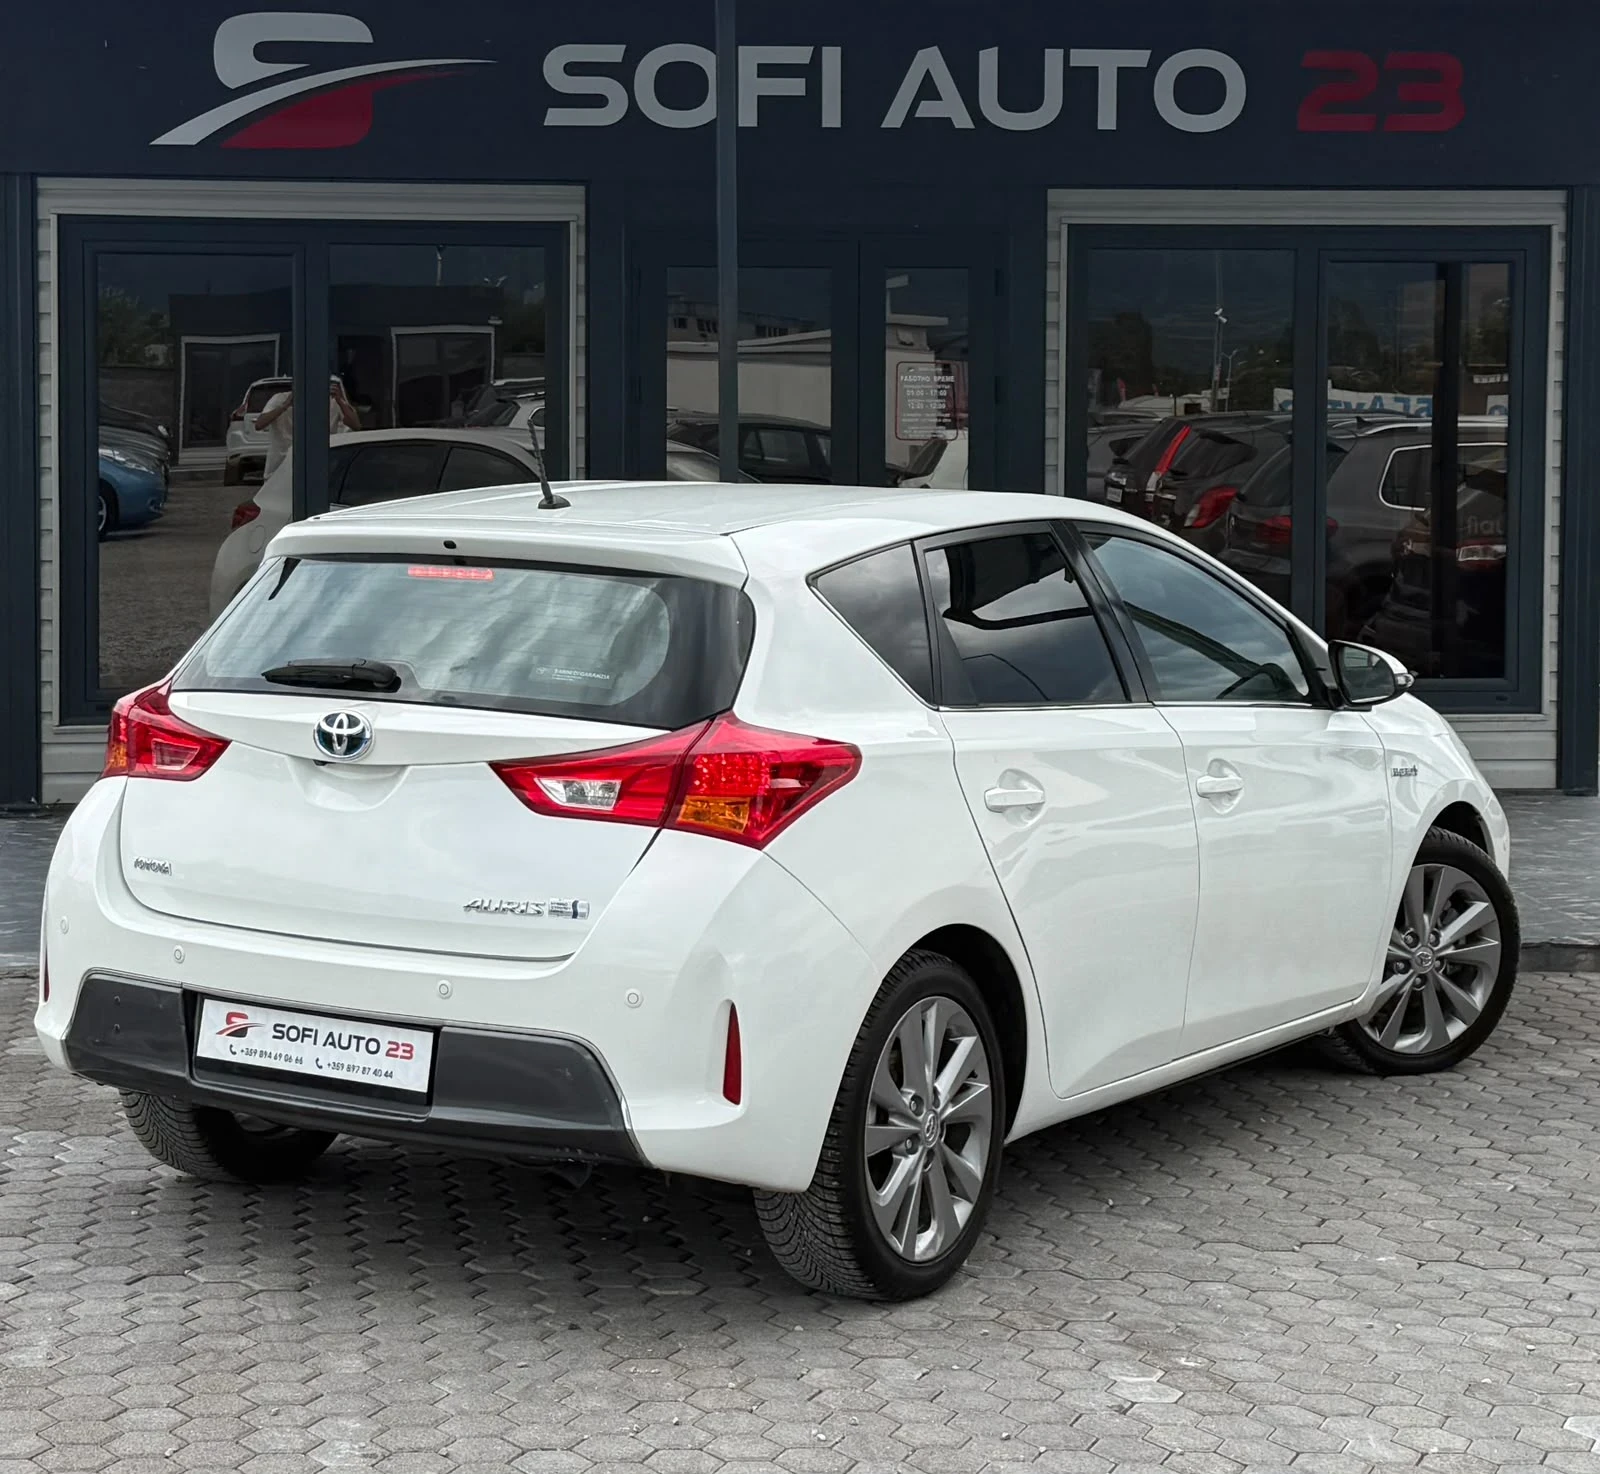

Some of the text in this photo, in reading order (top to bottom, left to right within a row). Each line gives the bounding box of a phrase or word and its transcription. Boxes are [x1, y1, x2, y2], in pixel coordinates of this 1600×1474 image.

[543, 43, 1466, 132] SOFI AUTO 23
[463, 899, 546, 917] AURIS
[272, 1023, 414, 1061] SOFI AUTO 23
[240, 1047, 258, 1057] +359
[273, 1052, 283, 1061] 69
[327, 1061, 345, 1071] +359
[361, 1066, 372, 1075] 87
[372, 1068, 382, 1077] 40
[383, 1070, 393, 1079] 44
